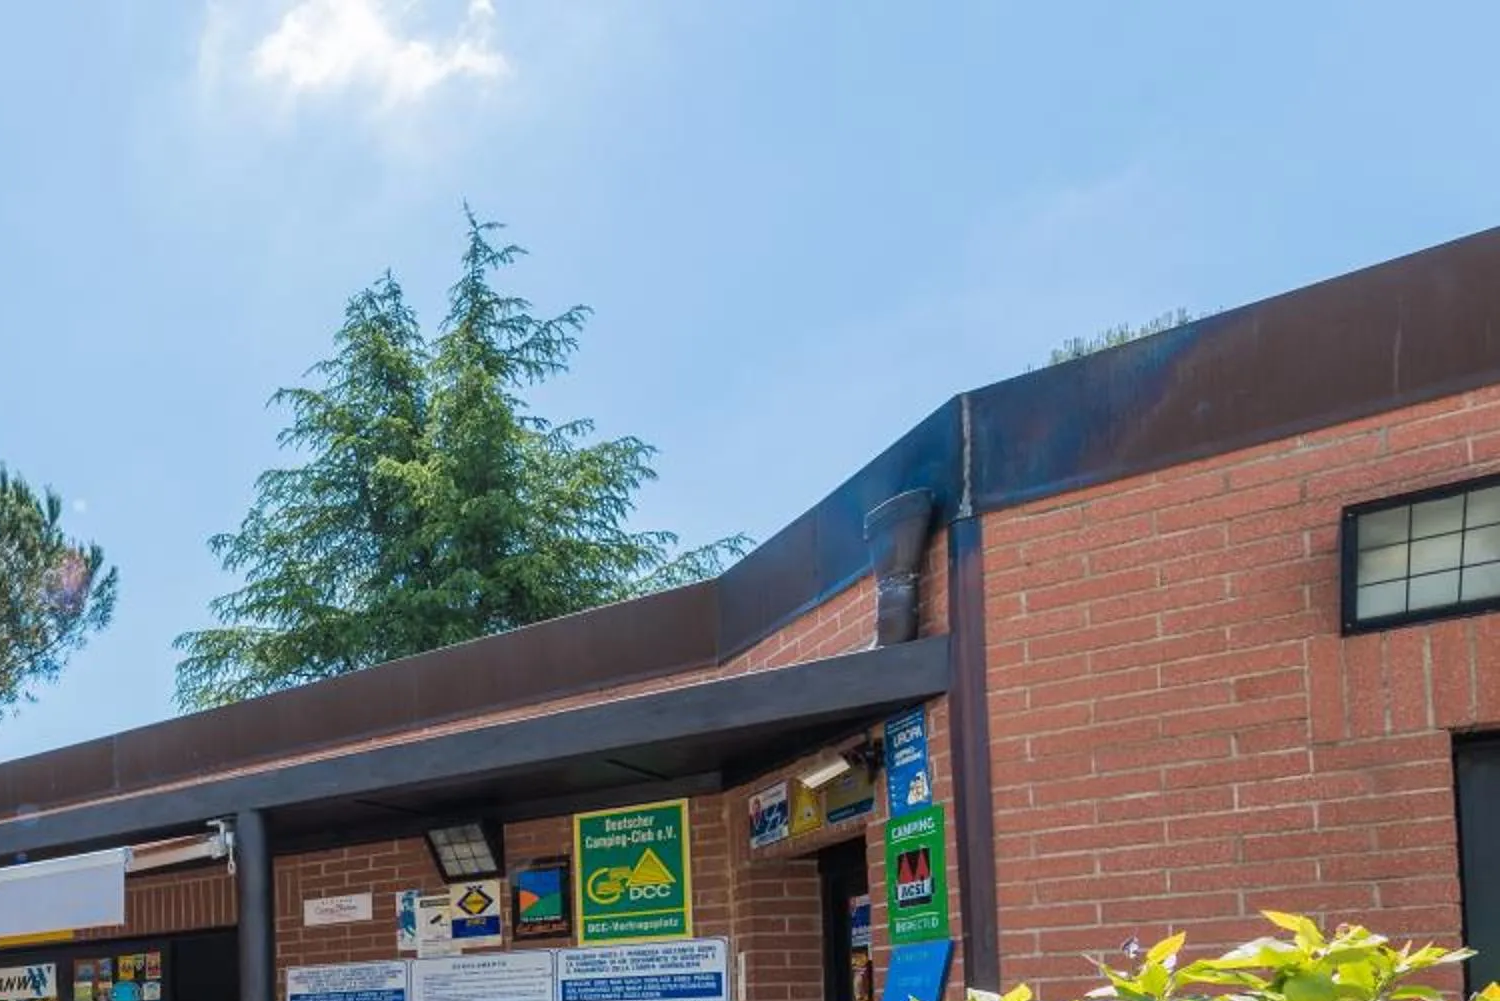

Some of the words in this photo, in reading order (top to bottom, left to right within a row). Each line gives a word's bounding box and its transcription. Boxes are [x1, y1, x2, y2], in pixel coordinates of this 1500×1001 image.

[605, 815, 655, 832] Deutscher
[891, 817, 935, 840] CAMPING
[585, 830, 654, 849] Camping-Club
[629, 884, 672, 901] DCC
[901, 882, 926, 898] ACSI
